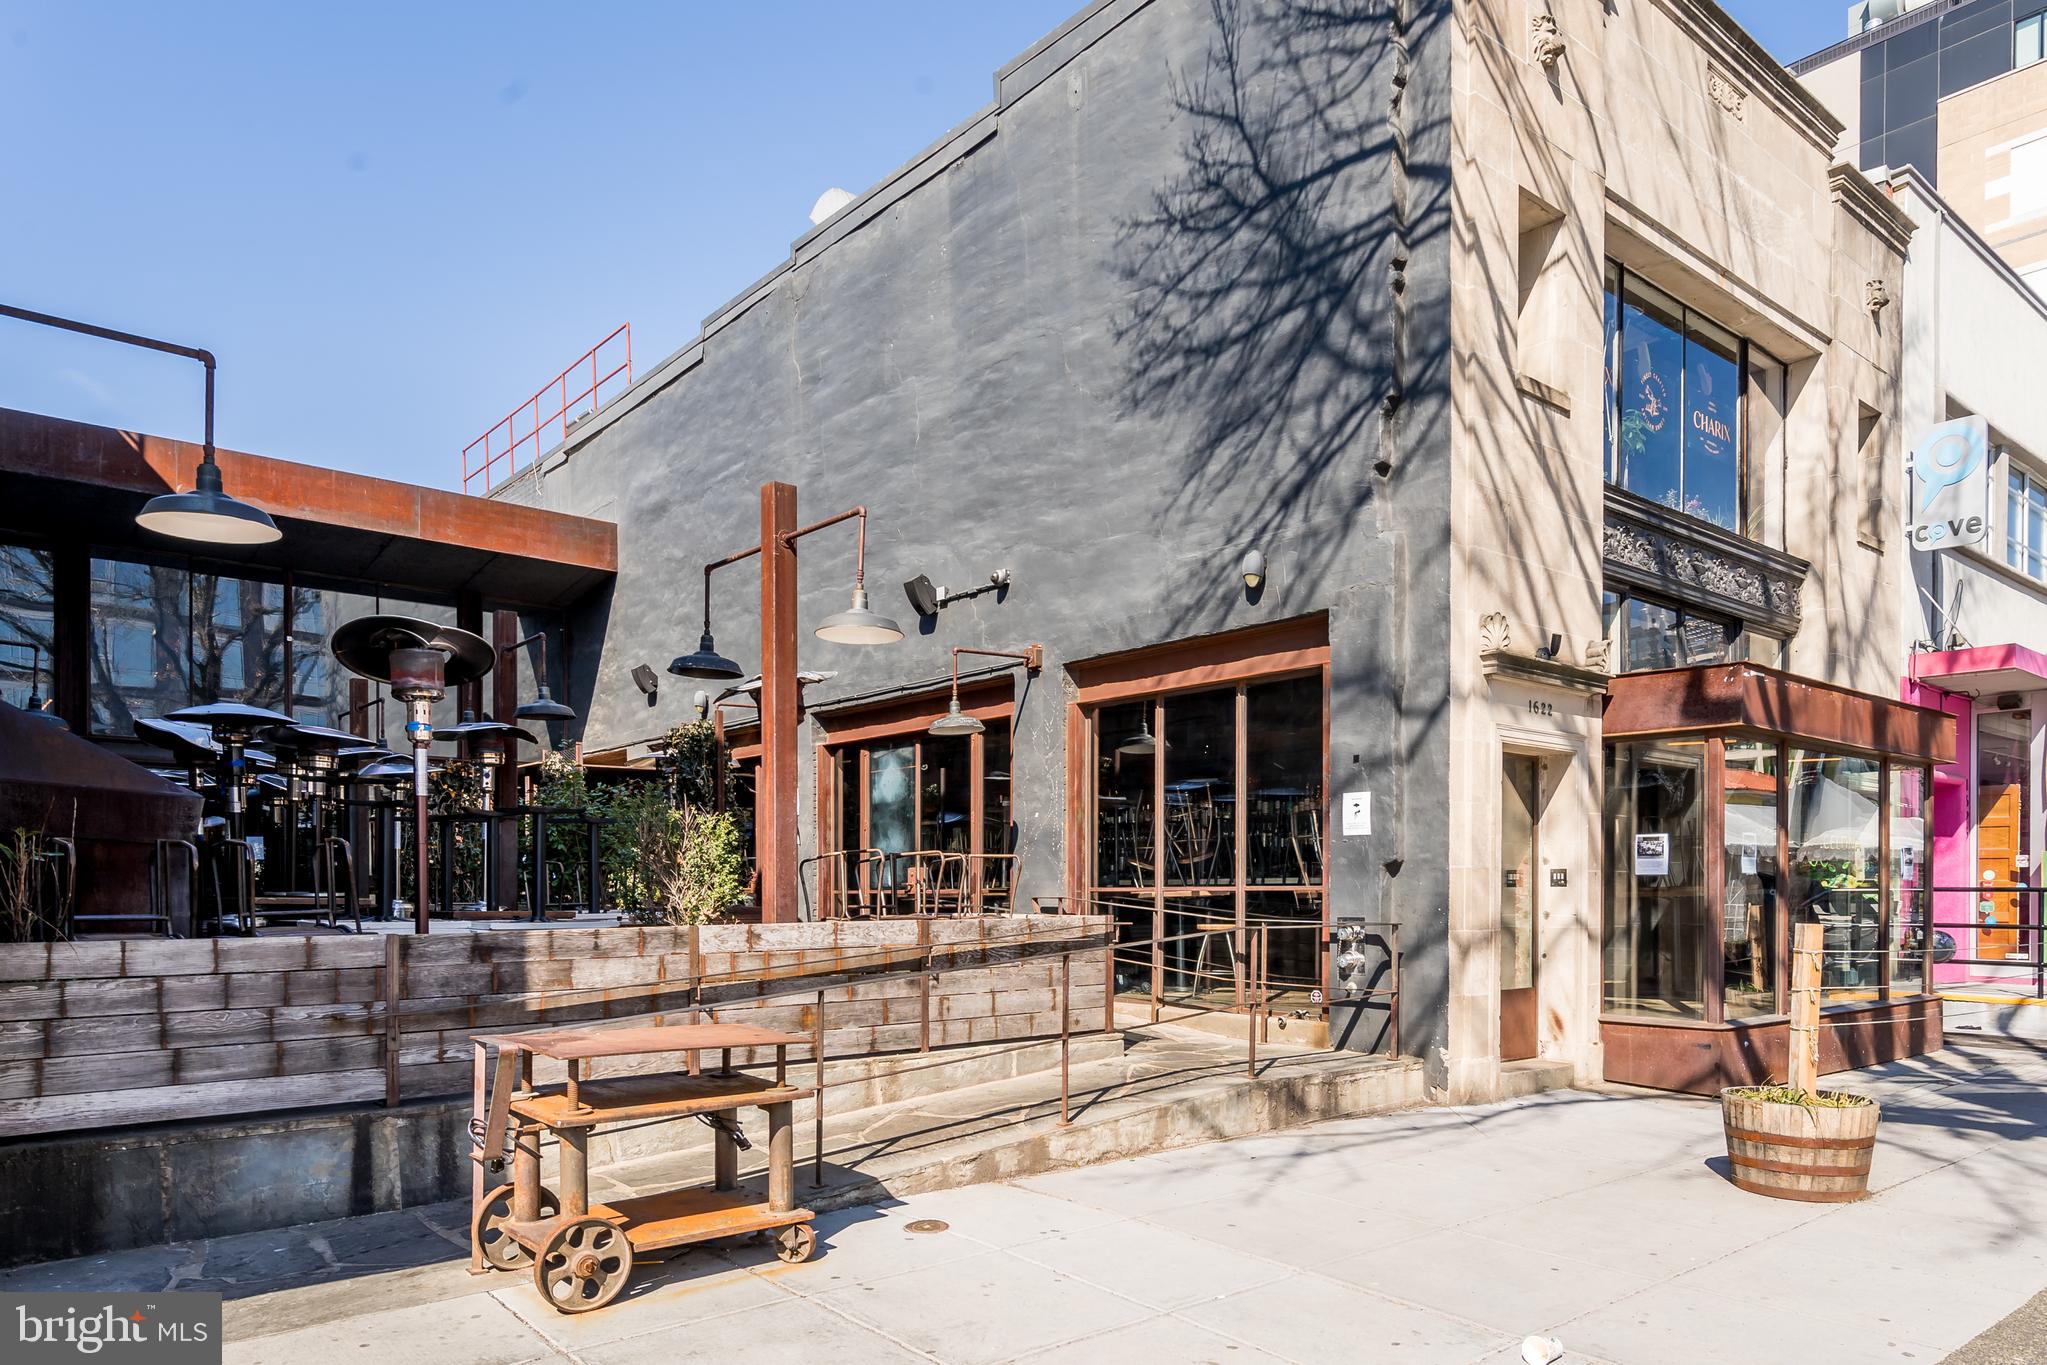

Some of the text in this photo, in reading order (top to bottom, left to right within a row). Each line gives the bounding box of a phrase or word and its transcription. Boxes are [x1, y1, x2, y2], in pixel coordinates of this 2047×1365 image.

[1693, 410, 1731, 445] CHARIX
[1914, 516, 1983, 545] cove
[1529, 700, 1552, 716] 1622
